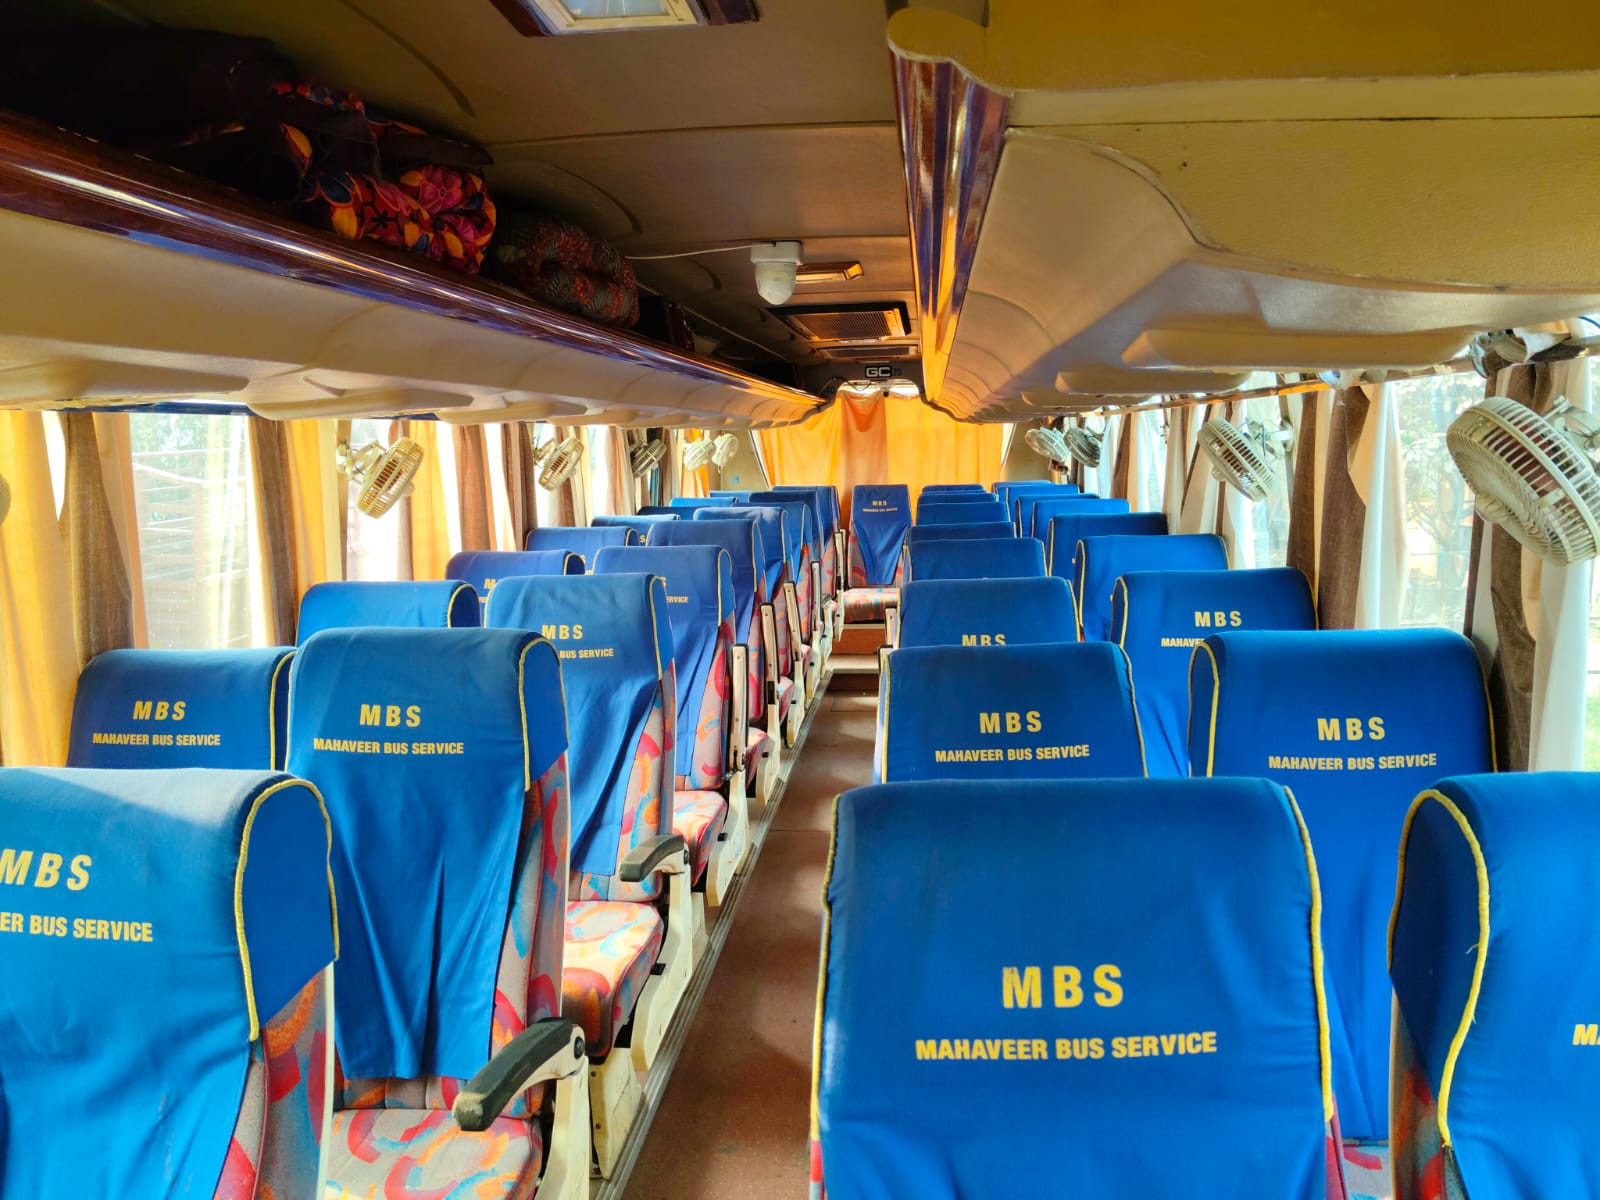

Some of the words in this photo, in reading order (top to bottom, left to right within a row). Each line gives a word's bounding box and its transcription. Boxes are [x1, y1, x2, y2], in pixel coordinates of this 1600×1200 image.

[866, 366, 891, 377] GC
[1194, 610, 1242, 627] MBS
[541, 624, 583, 640] MBS
[560, 650, 577, 658] BUS
[578, 647, 614, 659] SERVICE
[132, 700, 187, 721] MBS
[359, 703, 421, 728] MBS
[979, 710, 1042, 734] MBS
[1317, 716, 1385, 741] MBS
[92, 732, 150, 746] MAHAVEER
[152, 734, 174, 746] BUS
[175, 734, 220, 746] SERVICE
[313, 738, 381, 753] MAHAVEER
[383, 742, 409, 755] BUS
[411, 742, 464, 755] SERVICE
[935, 748, 1004, 763] MAHAVEER
[1007, 747, 1033, 761] BUS
[1035, 744, 1089, 760] SERVICE
[1268, 756, 1343, 770] MAHAVEER
[1347, 757, 1375, 770] BUS
[1379, 753, 1436, 769] SERVICE
[0, 848, 92, 891] MBS
[29, 915, 68, 937] BUS
[73, 918, 153, 943] SERVICE
[1002, 964, 1124, 1009] MBS
[915, 1039, 1048, 1060] MAHAVEER
[1055, 1037, 1105, 1060] BUS
[1111, 1031, 1217, 1059] SERVICE
